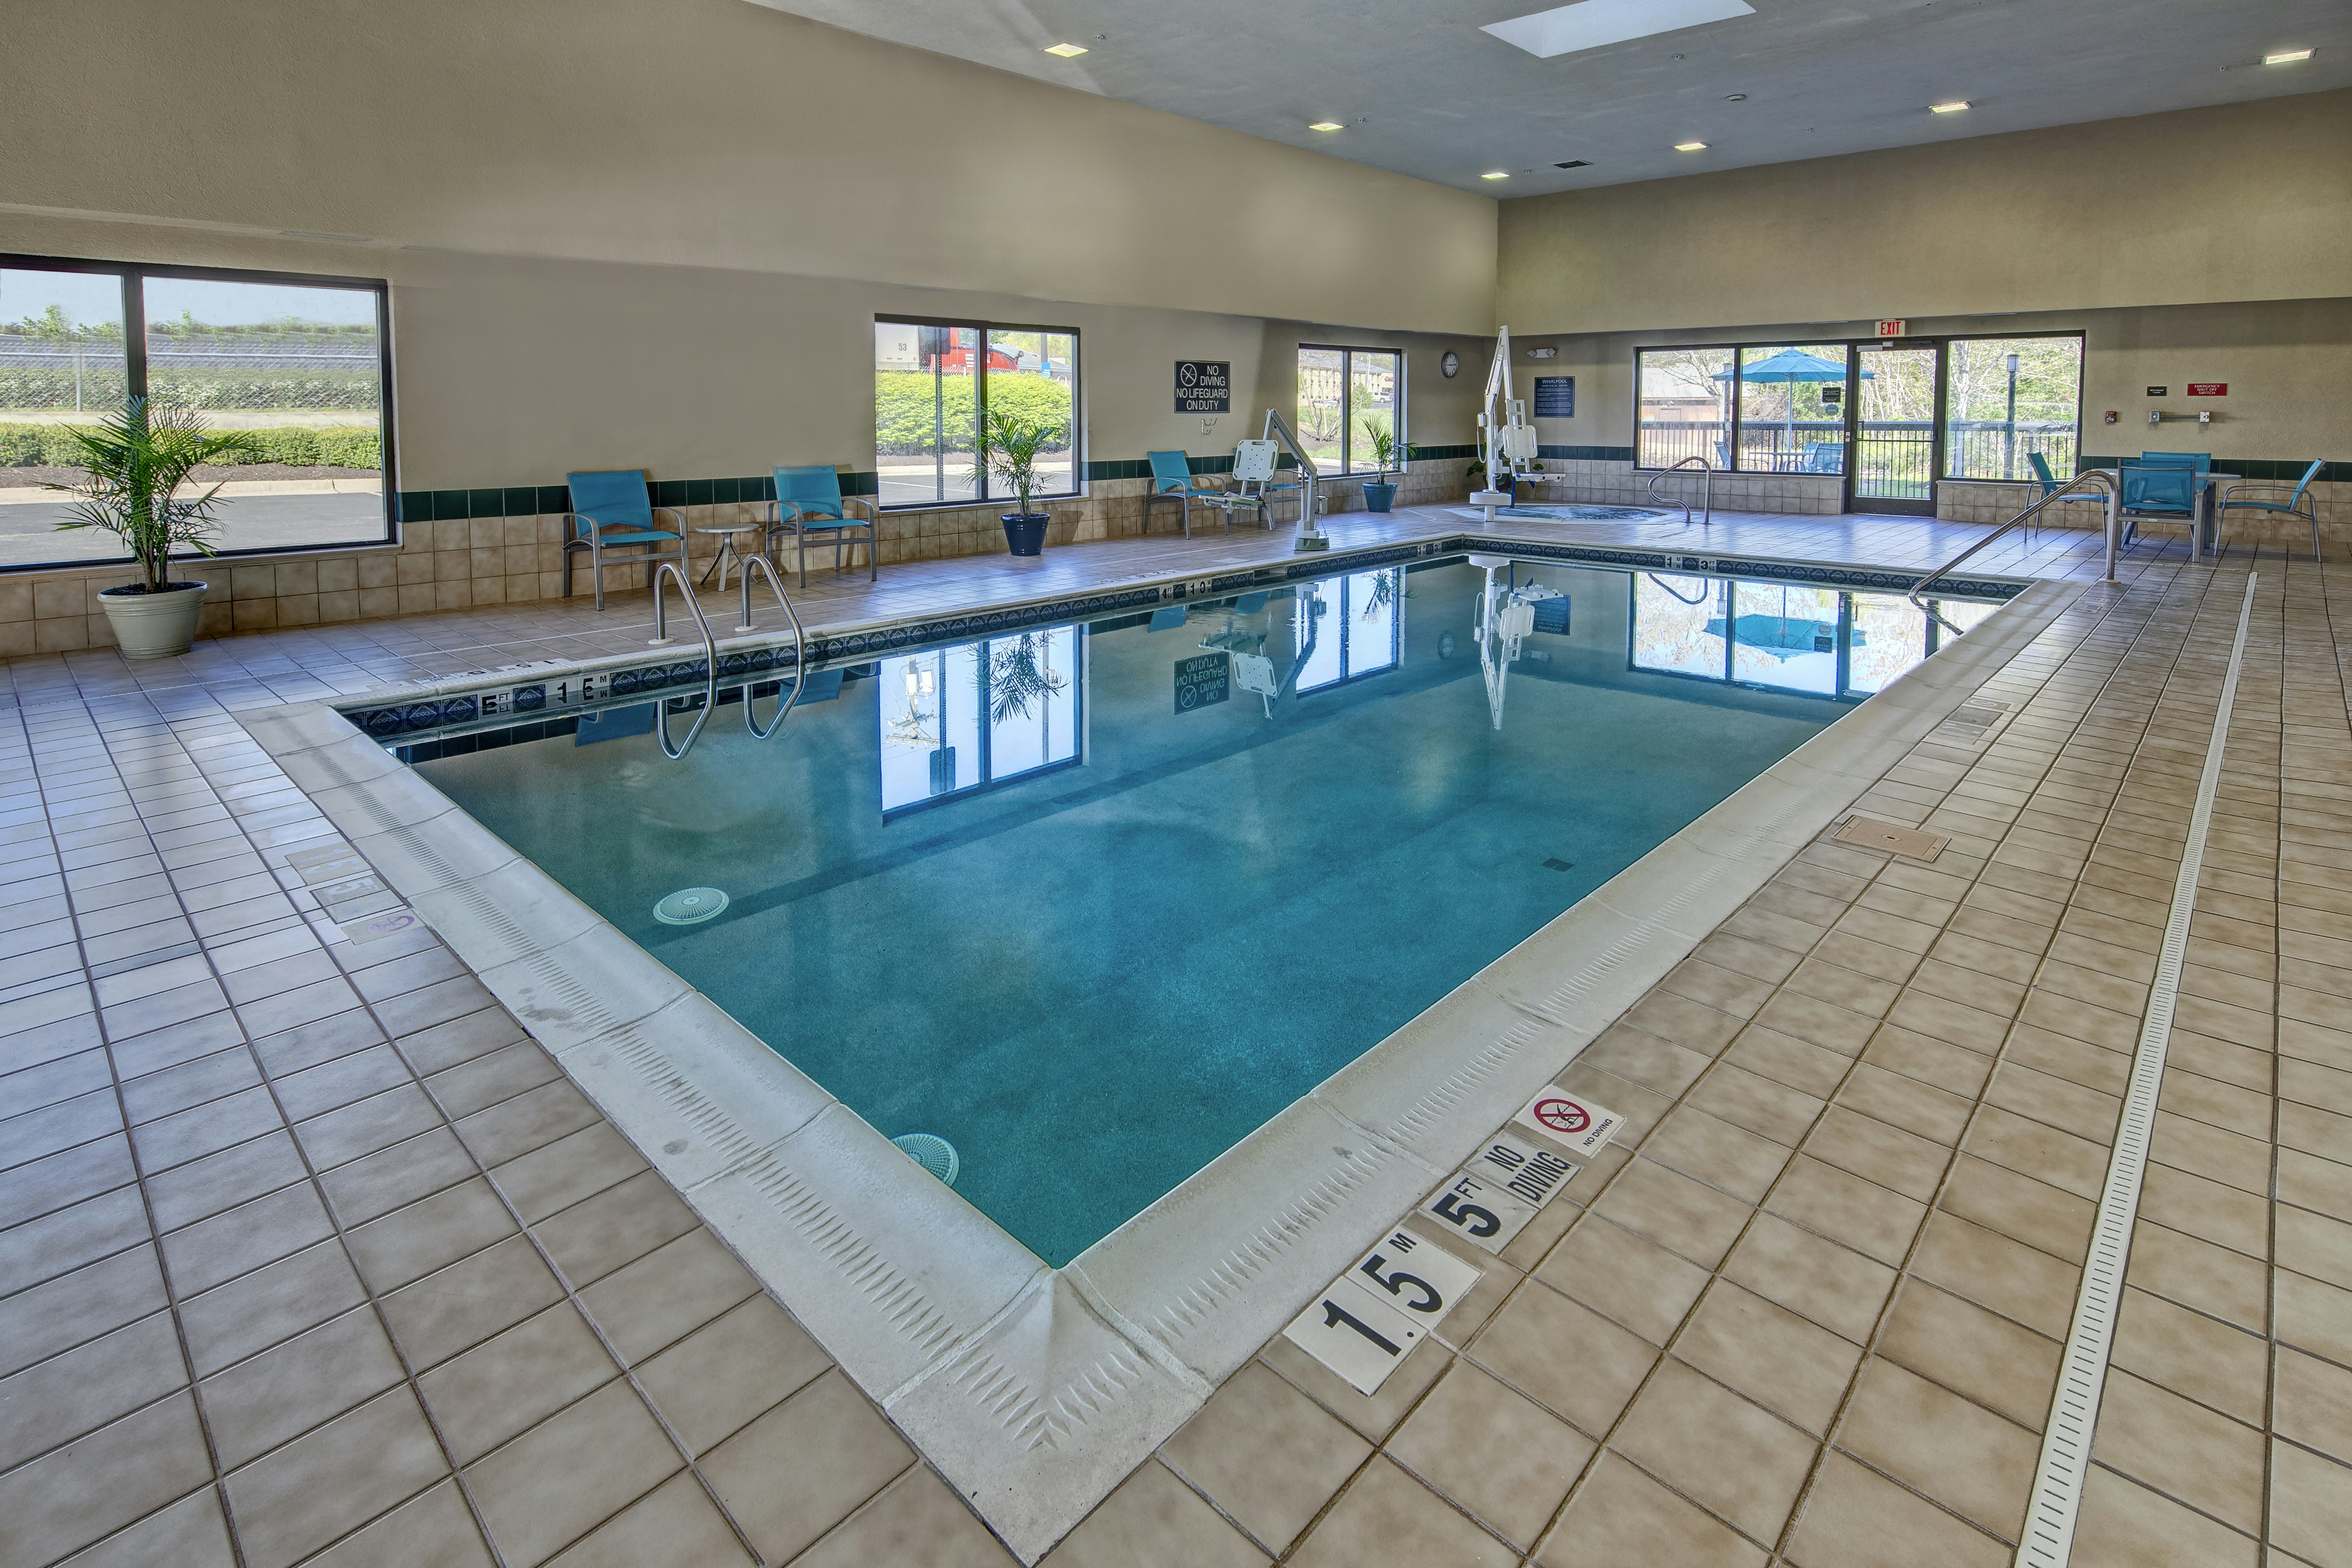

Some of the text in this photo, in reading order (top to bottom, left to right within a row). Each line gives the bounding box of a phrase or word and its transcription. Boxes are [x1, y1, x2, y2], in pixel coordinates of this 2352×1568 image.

[1881, 321, 1901, 335] EXIT
[1207, 365, 1218, 375] NO
[1200, 376, 1225, 386] DIVING
[1177, 388, 1228, 398] NO LIFEGUARD
[1186, 400, 1218, 410] ON DUTY
[557, 682, 566, 697] 1
[582, 677, 594, 693] 5
[482, 693, 510, 709] 5 FT
[327, 879, 379, 895] 5 FT
[1583, 1117, 1614, 1148] NO DIVING
[1484, 1144, 1526, 1172] NO
[1507, 1151, 1572, 1203] DIVING
[1431, 1177, 1501, 1238] 5 FT
[1389, 1232, 1417, 1254] M
